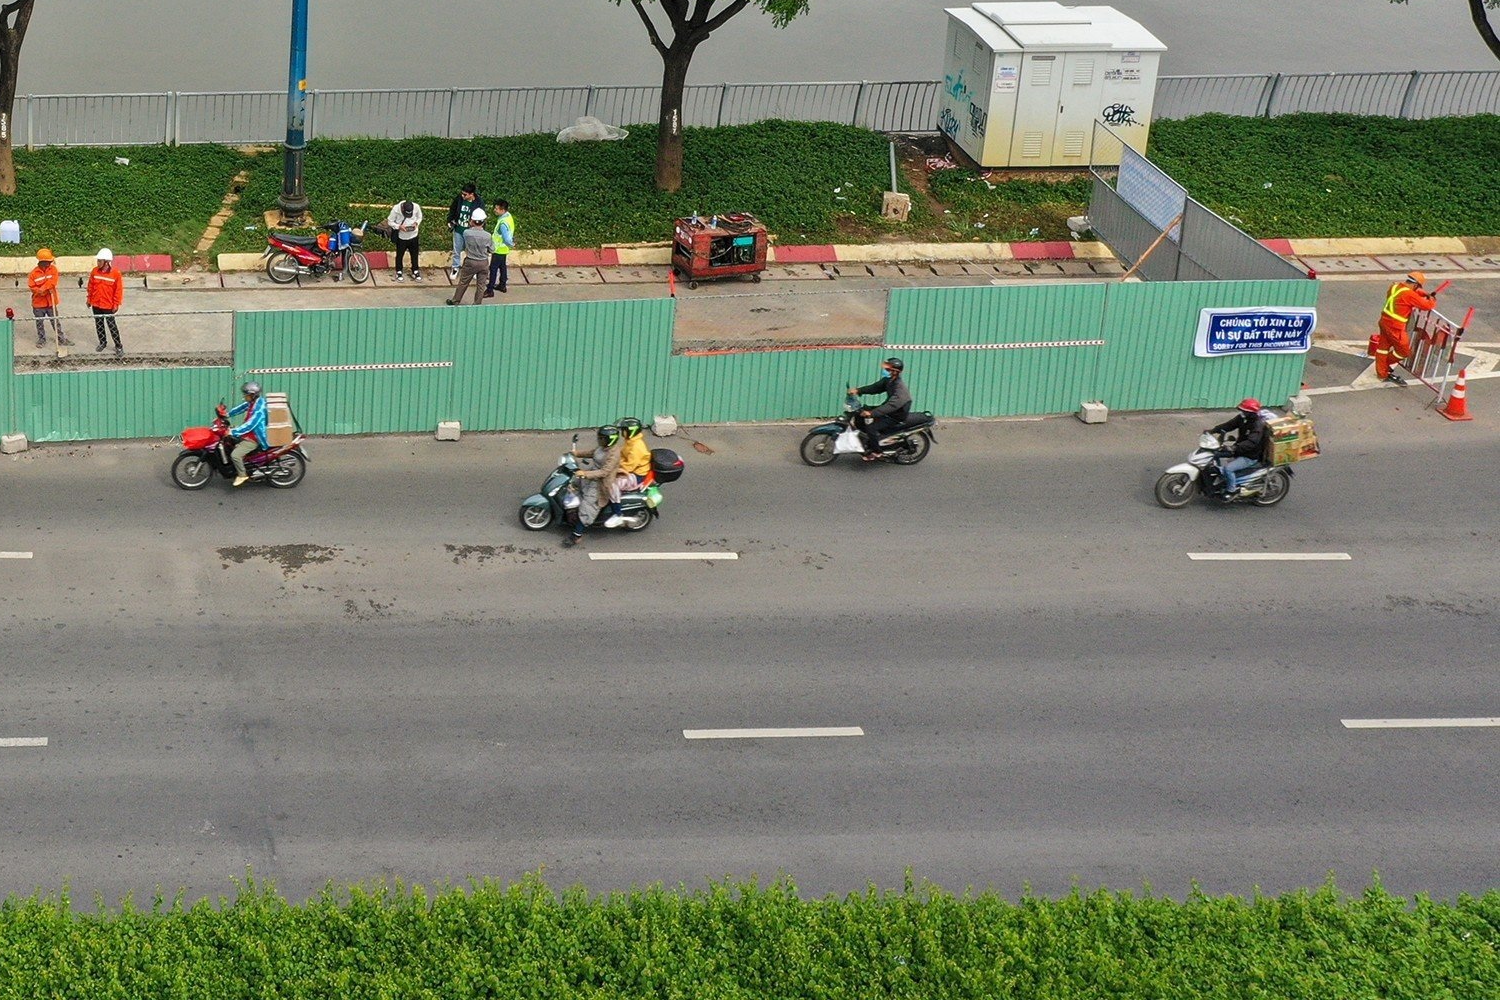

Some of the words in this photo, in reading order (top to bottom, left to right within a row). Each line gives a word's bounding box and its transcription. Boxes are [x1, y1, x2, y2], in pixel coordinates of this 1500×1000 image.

[1219, 317, 1251, 327] CHÚNG
[1253, 316, 1268, 327] TÔI
[1269, 318, 1286, 327] XIN
[1215, 329, 1225, 340] VÌ
[1227, 330, 1241, 342] SỰ
[1243, 328, 1260, 340] BẤT
[1262, 330, 1282, 341] TIỆN
[1284, 329, 1302, 338] NÀY
